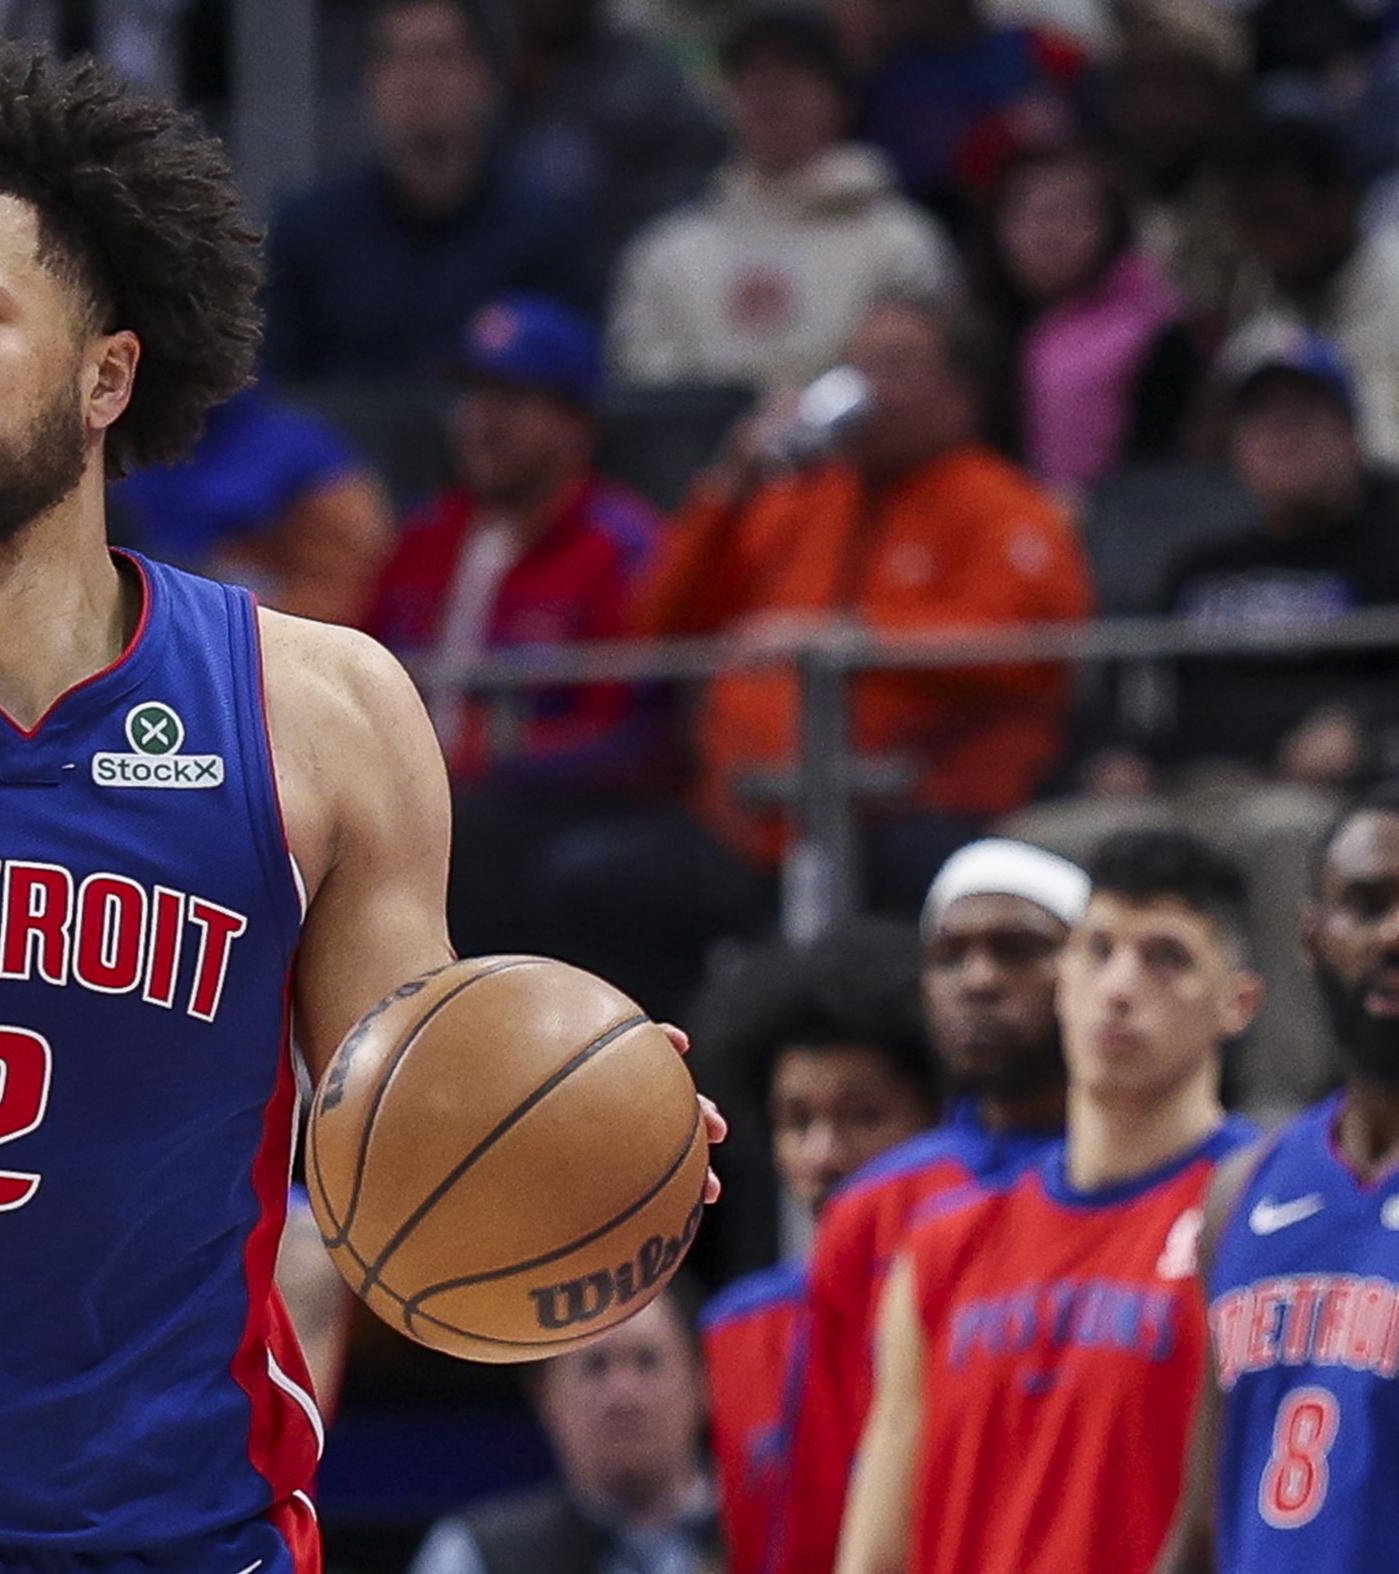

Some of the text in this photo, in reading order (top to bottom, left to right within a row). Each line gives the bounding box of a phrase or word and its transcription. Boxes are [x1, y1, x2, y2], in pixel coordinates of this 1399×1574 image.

[139, 717, 169, 746] X
[97, 757, 218, 783] StockX
[1257, 1384, 1341, 1530] 8
